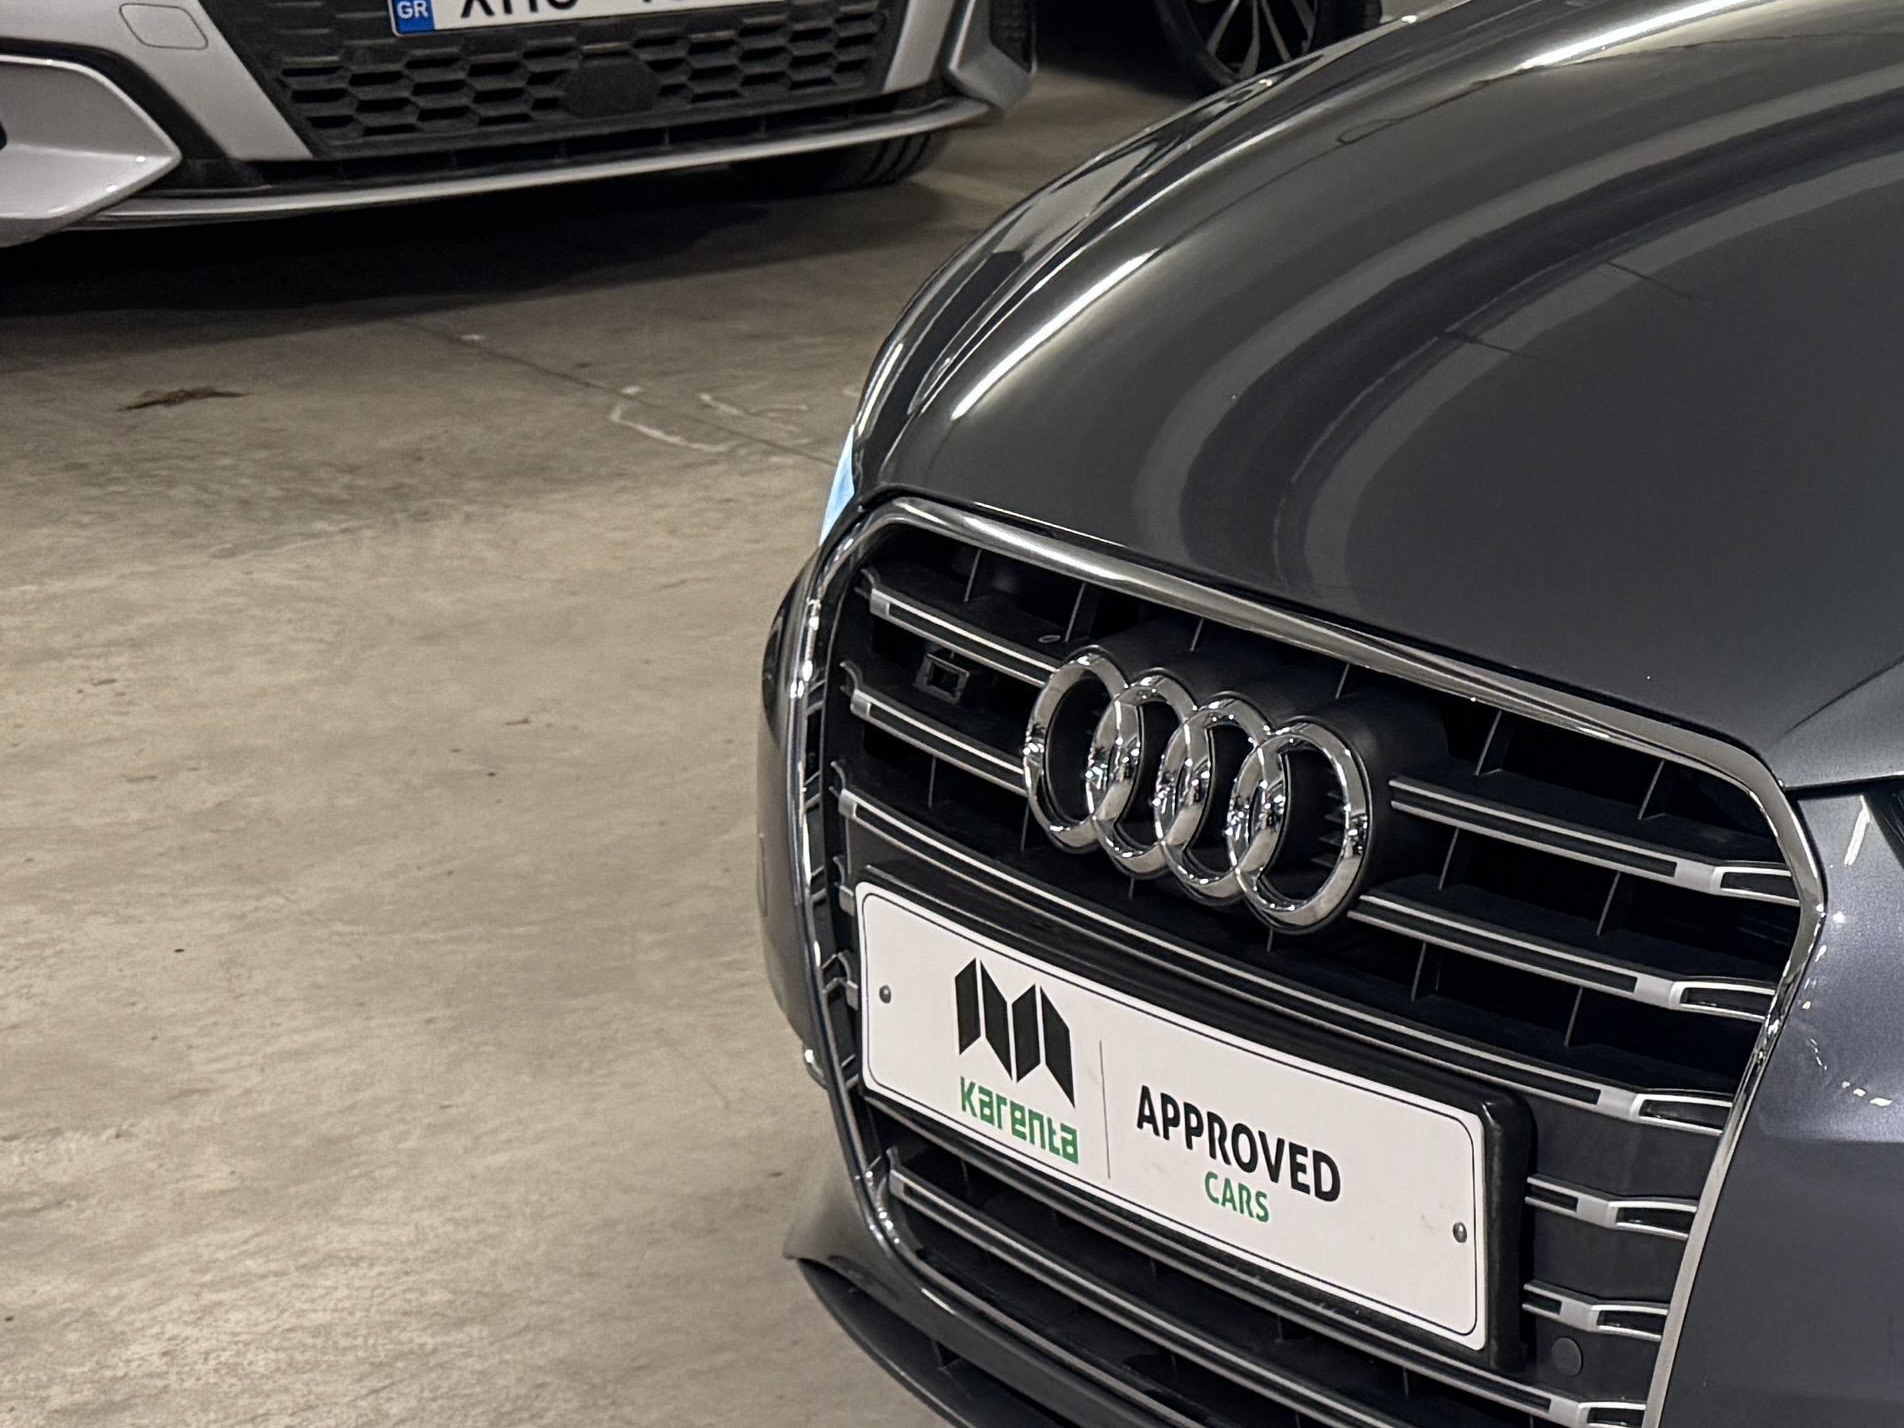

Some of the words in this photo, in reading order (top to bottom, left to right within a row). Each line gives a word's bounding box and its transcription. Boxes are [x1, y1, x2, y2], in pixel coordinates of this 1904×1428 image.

[396, 0, 429, 20] GR
[1135, 1084, 1342, 1203] APPROVED
[1203, 1170, 1270, 1224] CARS
